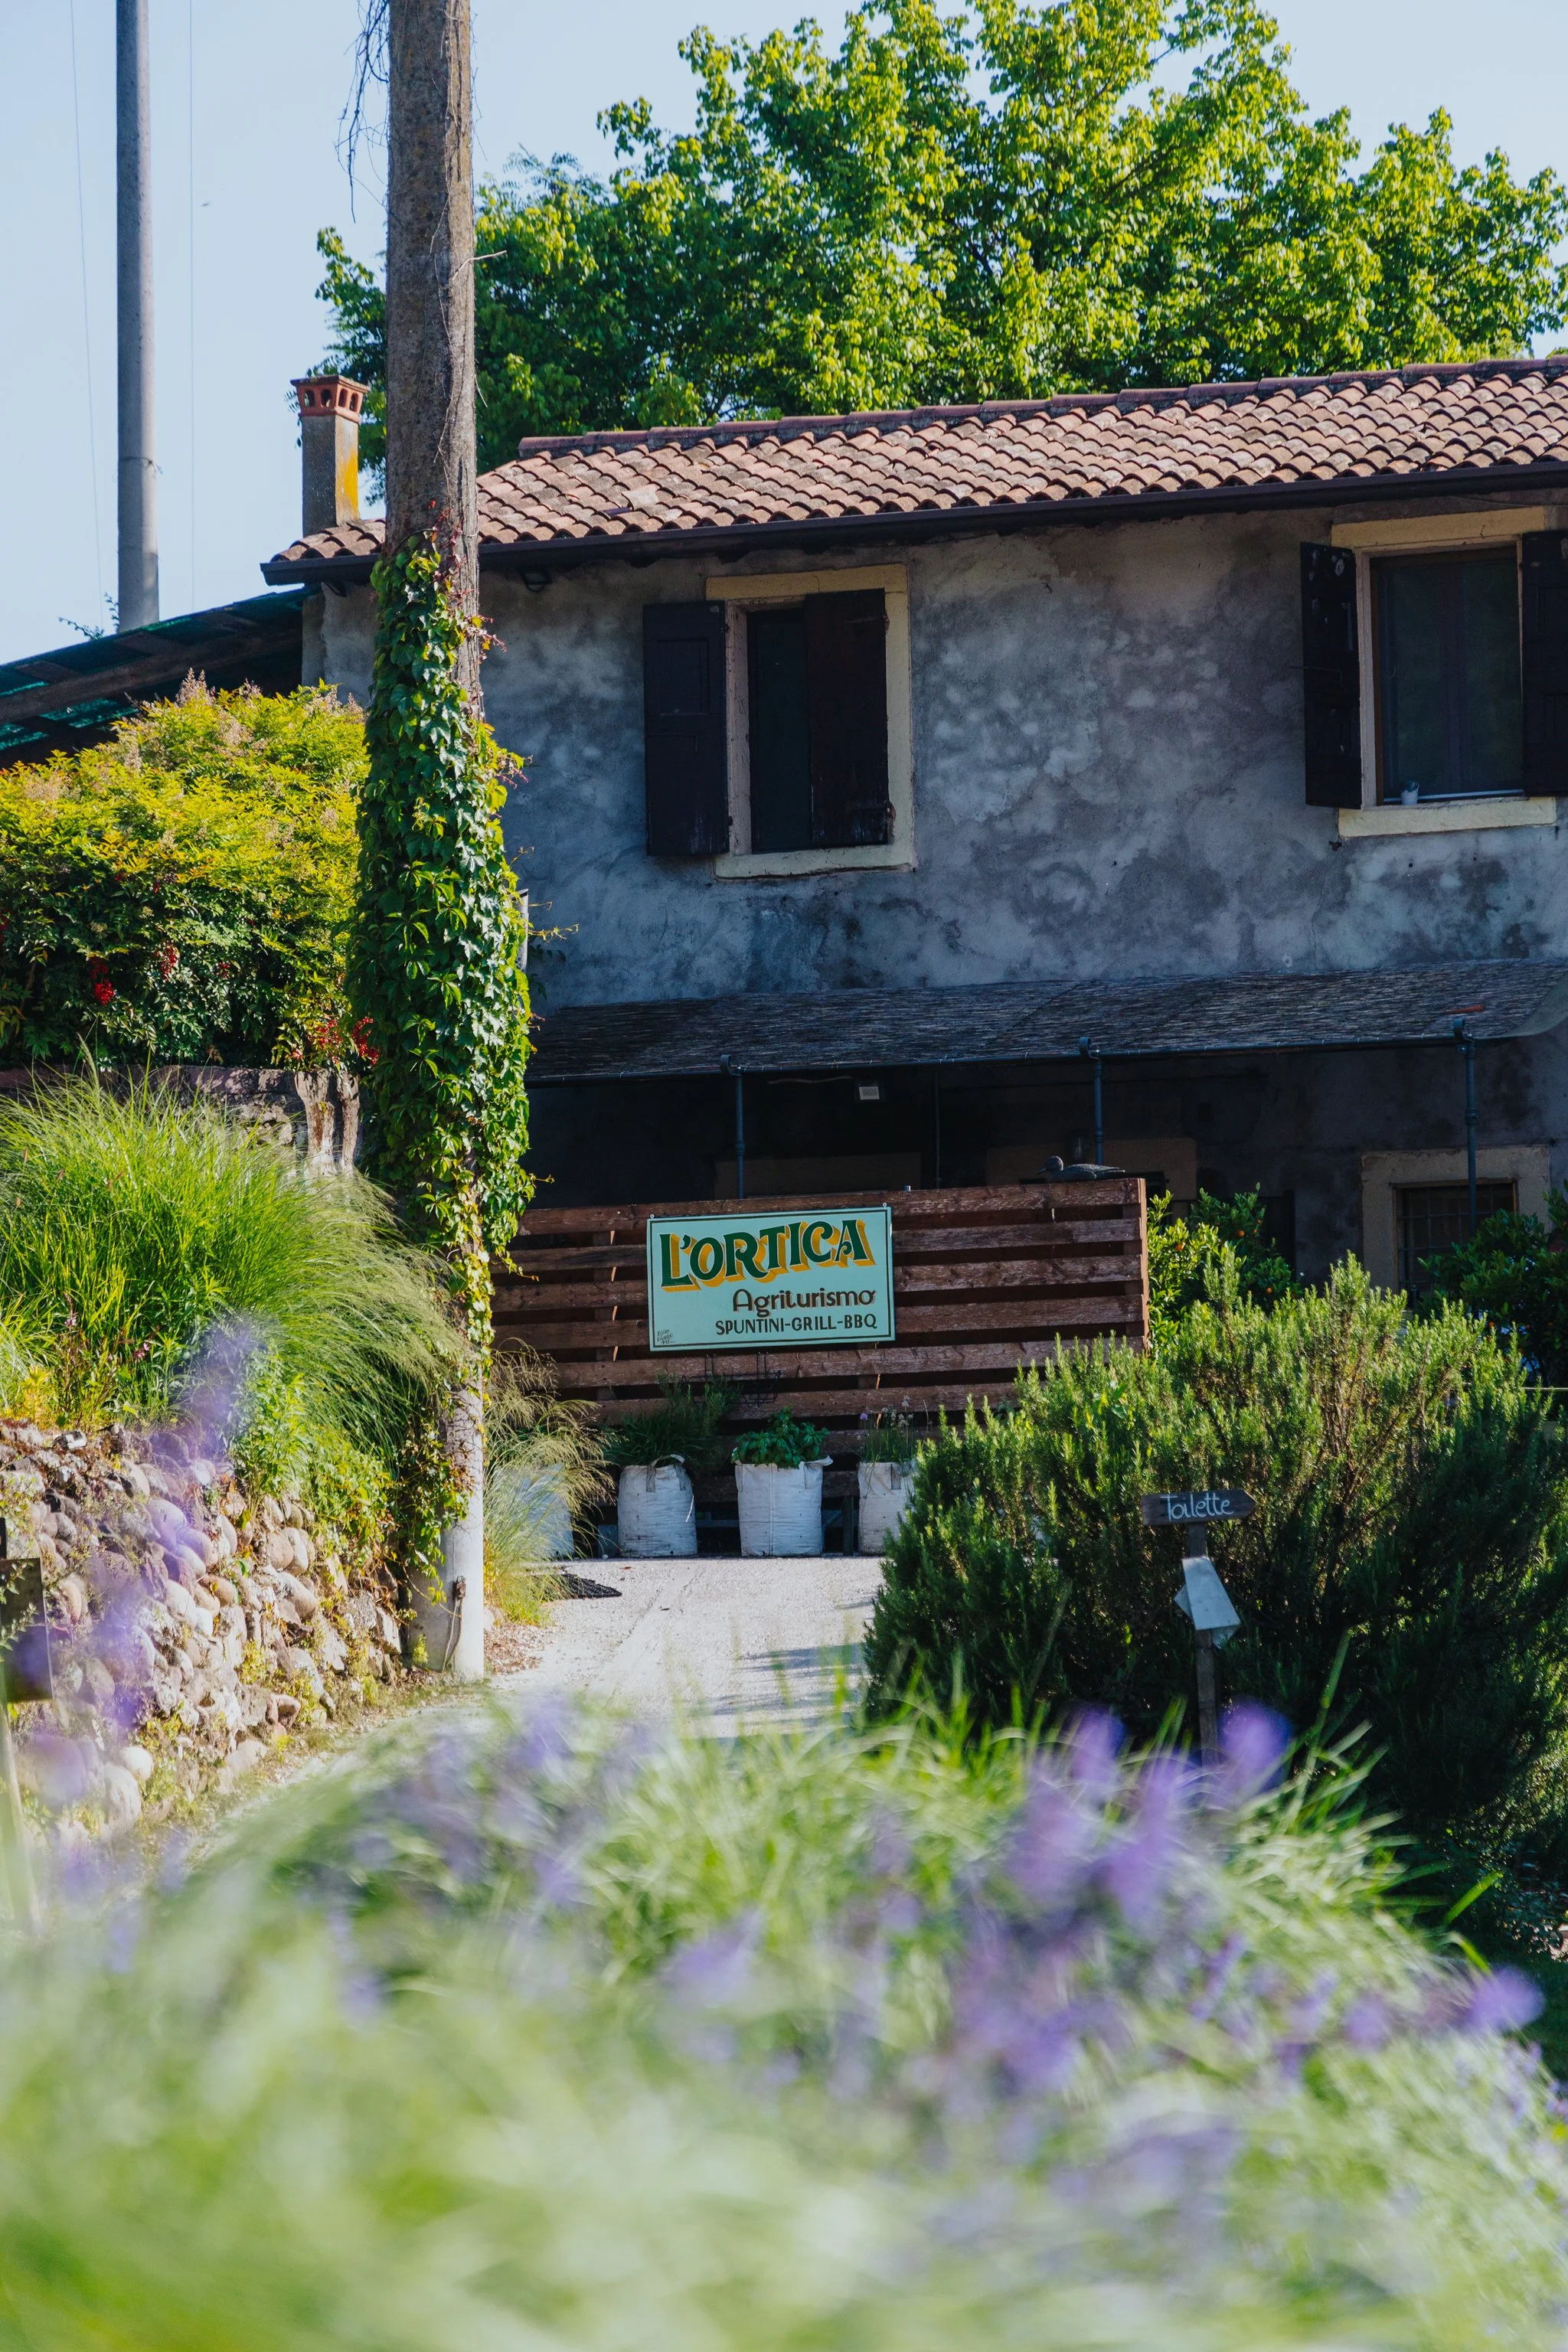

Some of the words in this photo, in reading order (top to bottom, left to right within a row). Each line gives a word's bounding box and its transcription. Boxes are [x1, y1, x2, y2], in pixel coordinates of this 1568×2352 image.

[658, 1219, 876, 1292] L'ORTICA
[733, 1287, 876, 1318] Agriturismo
[715, 1313, 877, 1336] SPUNTINI-GRILL-BBQ
[1160, 1492, 1235, 1522] Toilette
